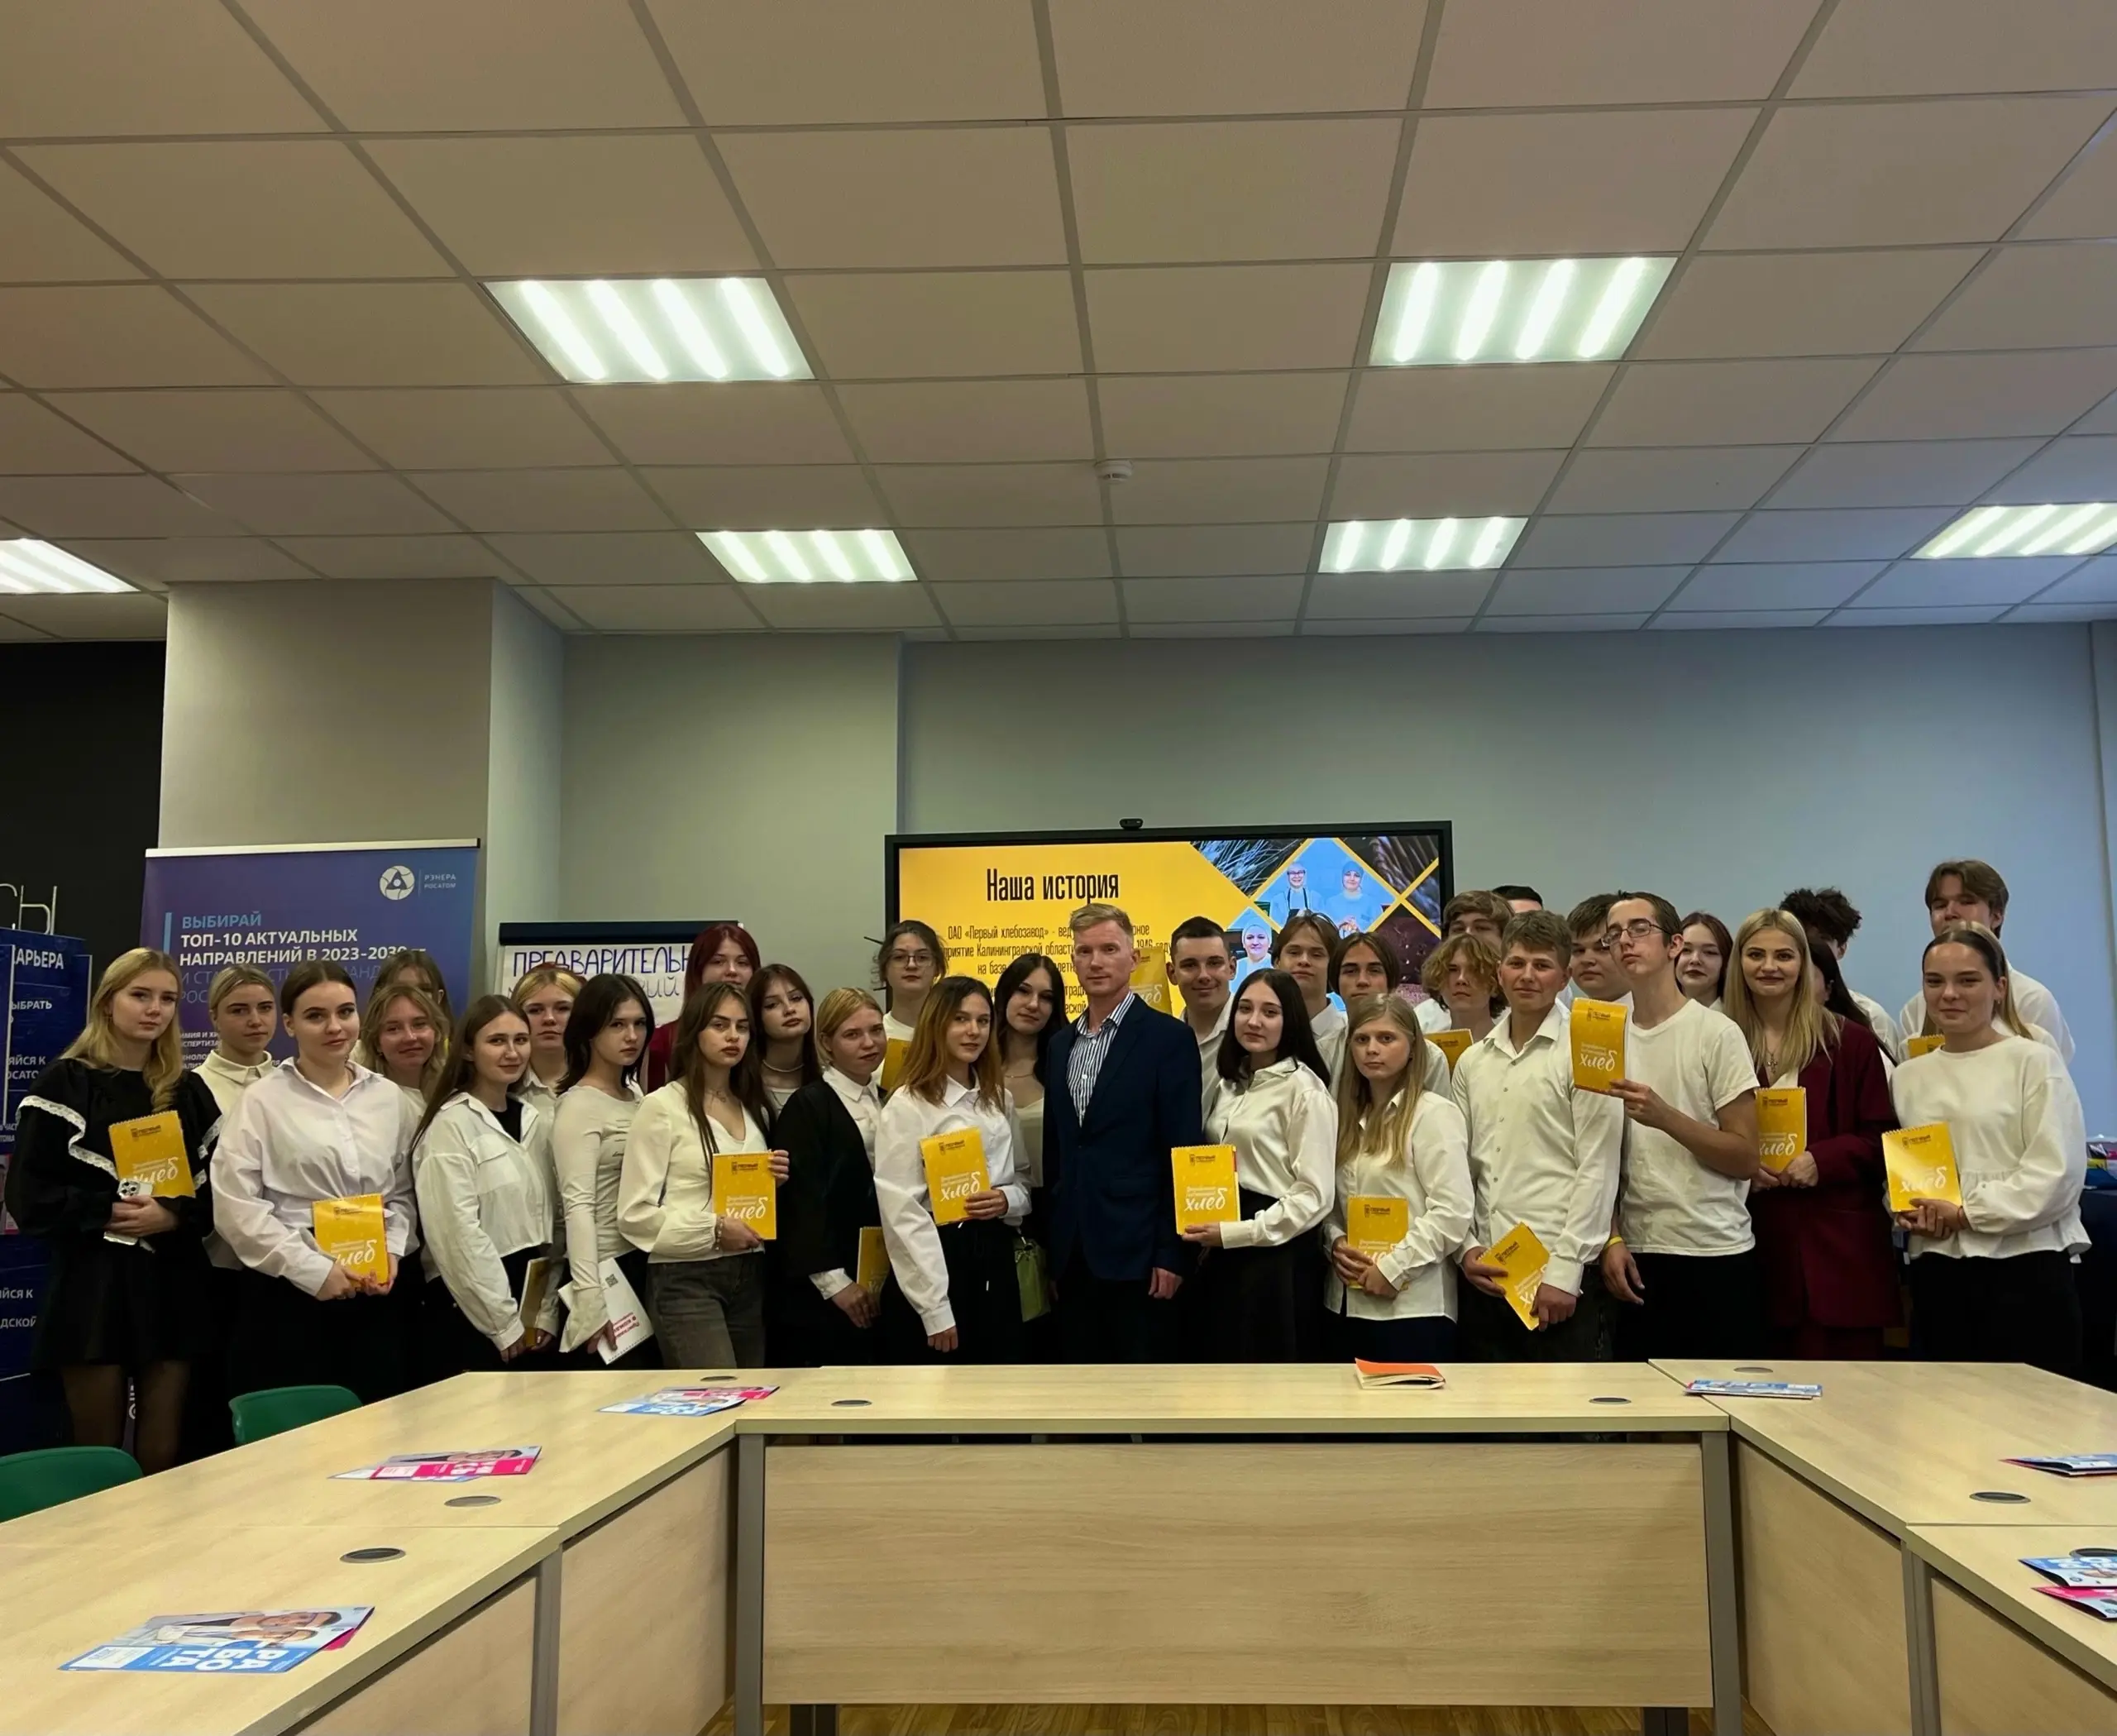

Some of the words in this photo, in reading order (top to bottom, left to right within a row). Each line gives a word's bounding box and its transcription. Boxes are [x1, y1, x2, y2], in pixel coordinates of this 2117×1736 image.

[987, 868, 1034, 901] Наша
[1042, 874, 1119, 903] история
[182, 911, 262, 929] ВЫБИРАЙ
[180, 933, 242, 949] ТОП-10
[245, 929, 358, 946] АКТУАЛЬНЫХ
[948, 925, 963, 940] ОАО
[965, 925, 998, 943] «Первый
[1001, 924, 1049, 940] хлебозавод»
[1058, 926, 1073, 940] вед
[14, 948, 65, 970] АРЬЕРА
[179, 946, 303, 967] НАПРАВЛЕНИЙ
[307, 949, 318, 961] В
[944, 946, 974, 960] приятие
[977, 942, 1043, 959] Калининградской
[513, 945, 691, 977] ПРДВАРИТЕЛЬН
[977, 964, 987, 975] на
[12, 1000, 53, 1011] ЫБРАТЬ
[1065, 1000, 1087, 1014] еской
[8, 1054, 37, 1066] ЯЙСЯ
[1579, 1049, 1618, 1072] хлеб
[7, 1069, 40, 1079] ОСАТО
[940, 1171, 982, 1202] хлеб
[1184, 1187, 1228, 1212] хлеб
[0, 1286, 24, 1299] ЙСЯ
[0, 1315, 37, 1330] ДСКОЙ
